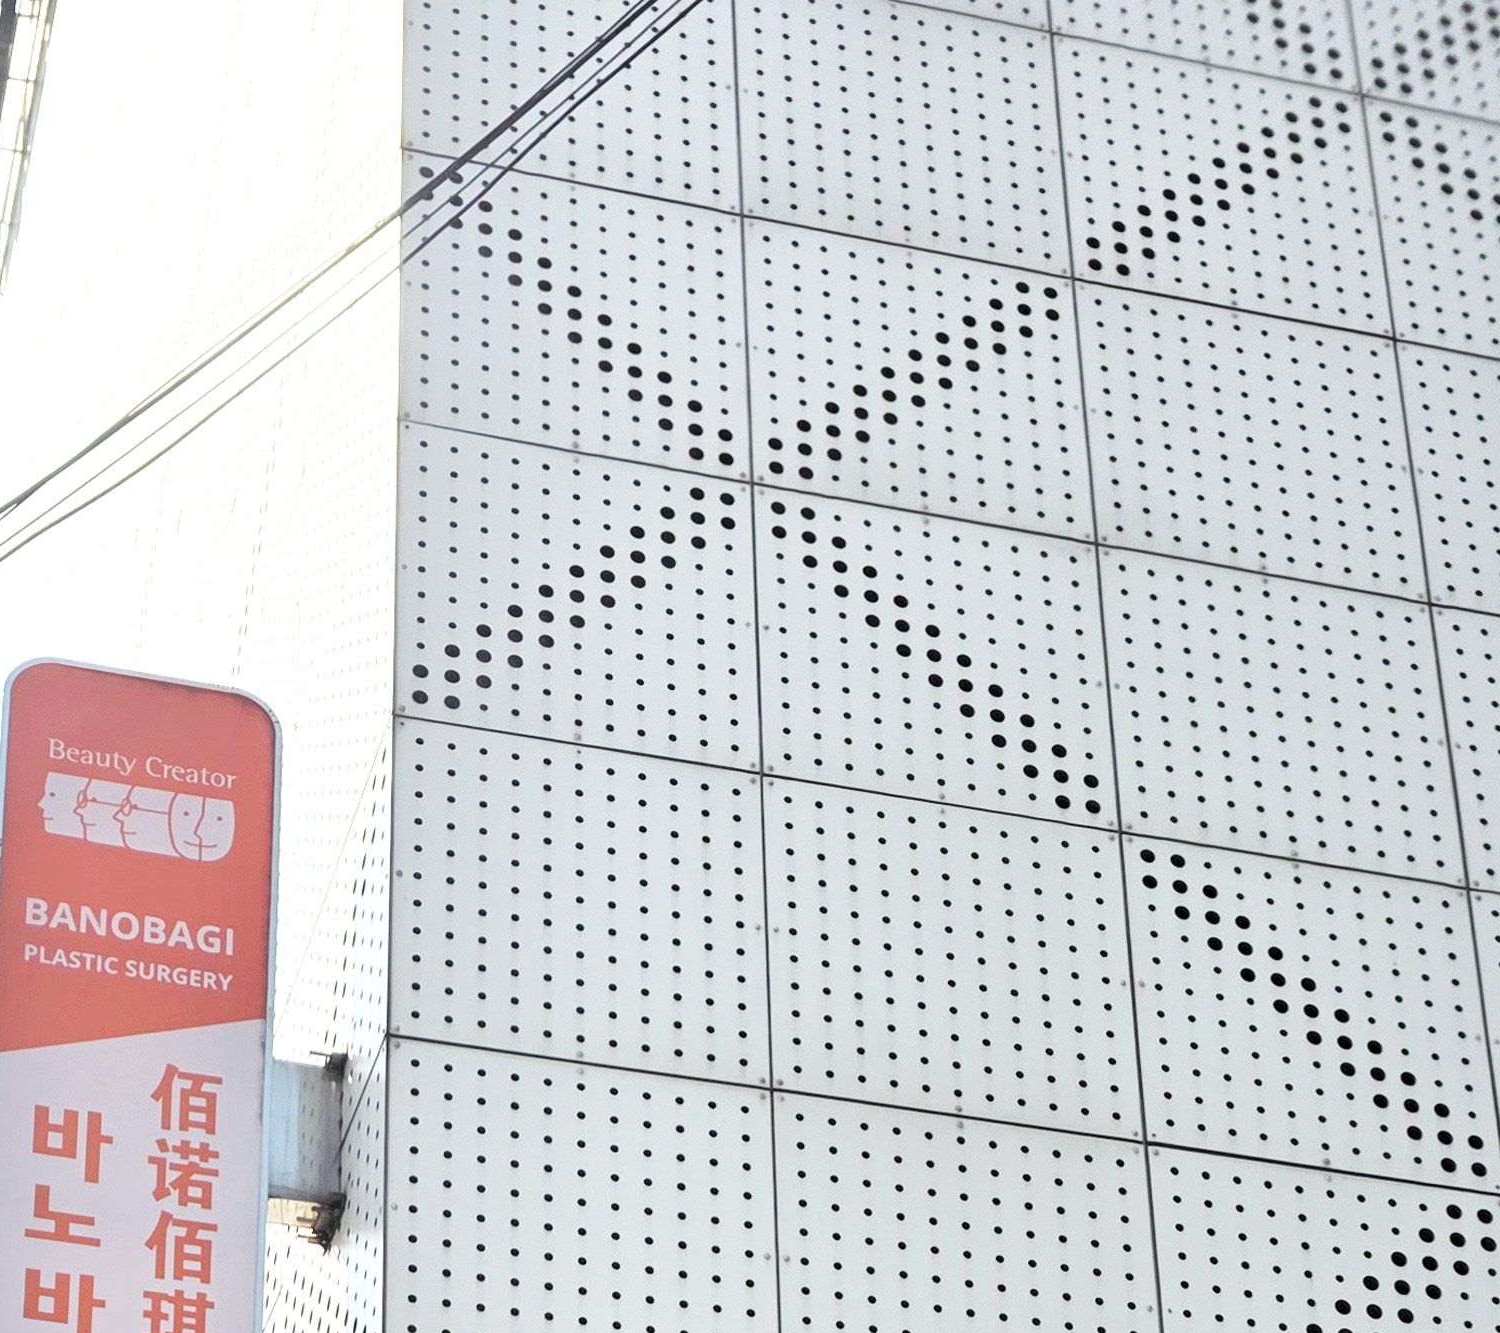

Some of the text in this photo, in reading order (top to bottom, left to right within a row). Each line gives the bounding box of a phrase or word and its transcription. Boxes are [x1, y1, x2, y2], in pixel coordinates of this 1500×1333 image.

[47, 738, 238, 789] Beauty Creator
[25, 897, 235, 955] BANOBAGI
[24, 944, 233, 991] PLASTIC SURGERY
